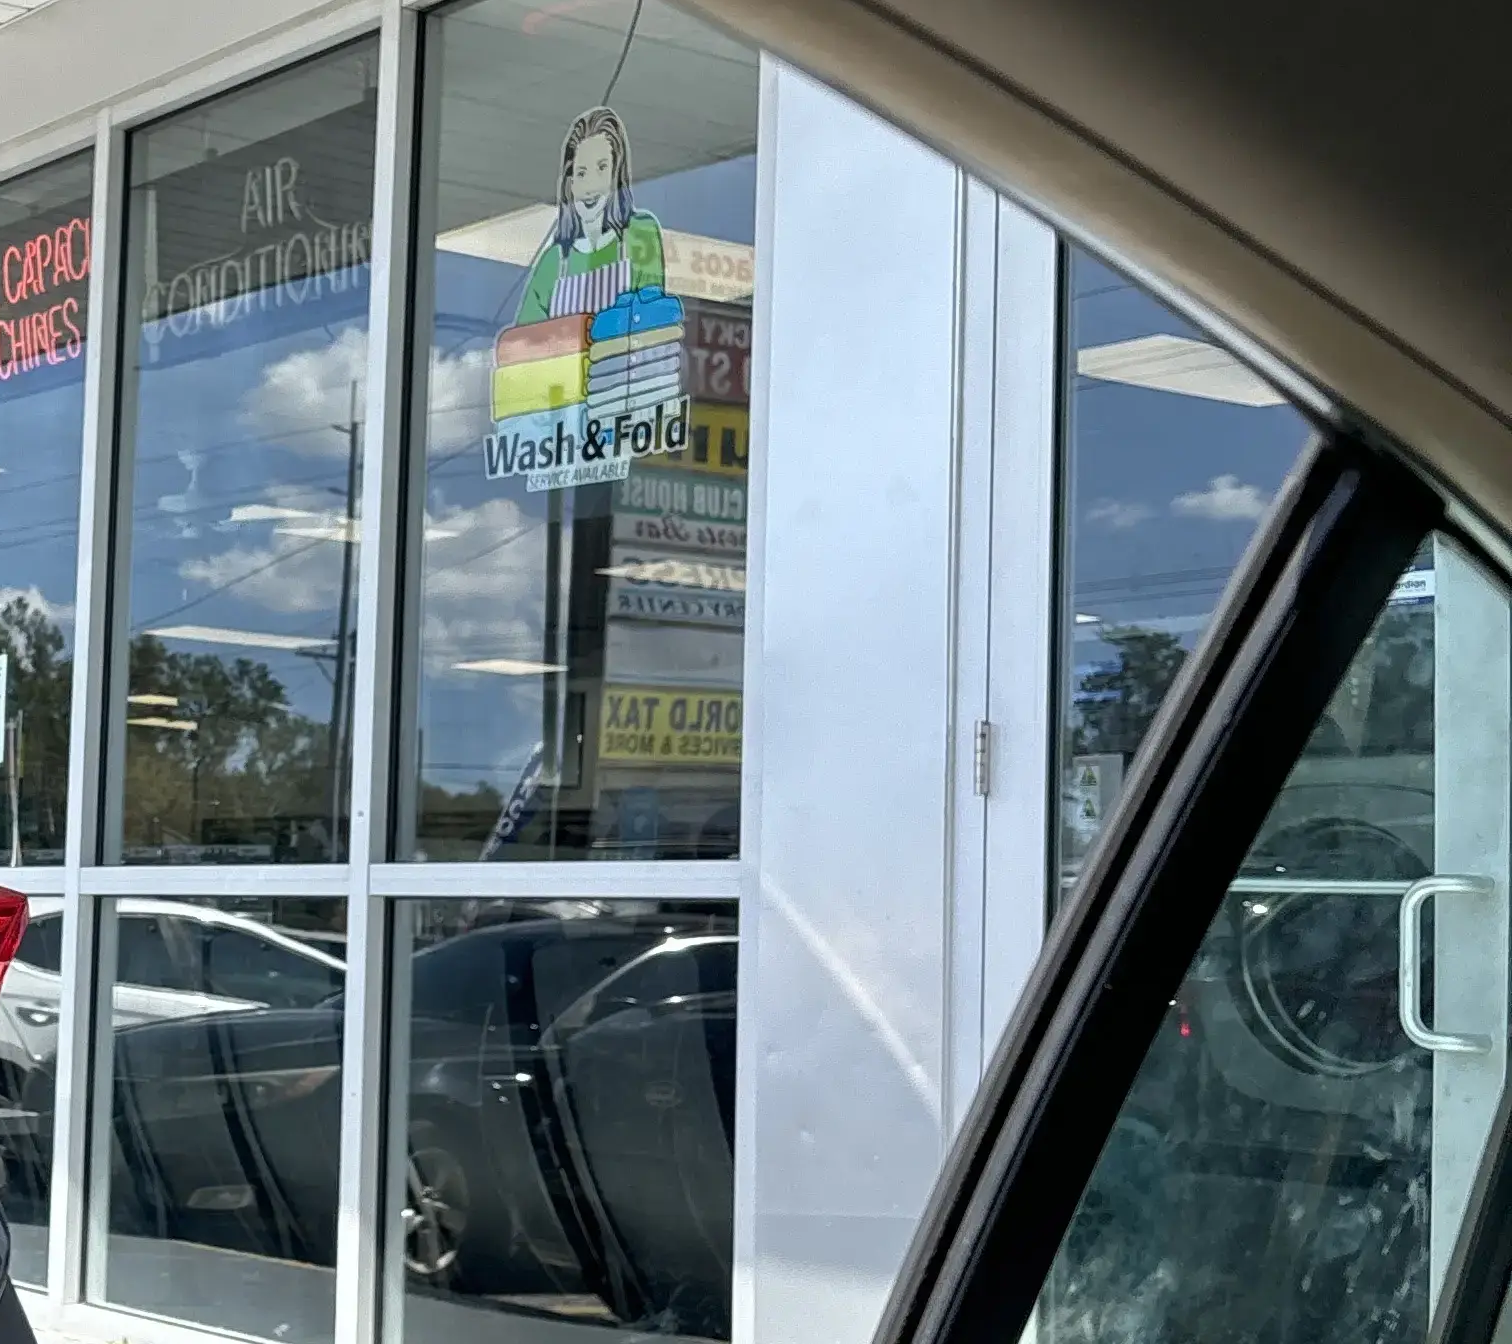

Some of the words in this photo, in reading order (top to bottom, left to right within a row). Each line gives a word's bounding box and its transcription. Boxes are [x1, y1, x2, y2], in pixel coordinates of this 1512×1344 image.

[241, 157, 302, 233] AIR
[3, 217, 91, 304] CAPACI
[143, 218, 372, 339] CONDITIONIN
[485, 421, 575, 476] Wash
[582, 419, 606, 462] &
[613, 399, 688, 456] Fold
